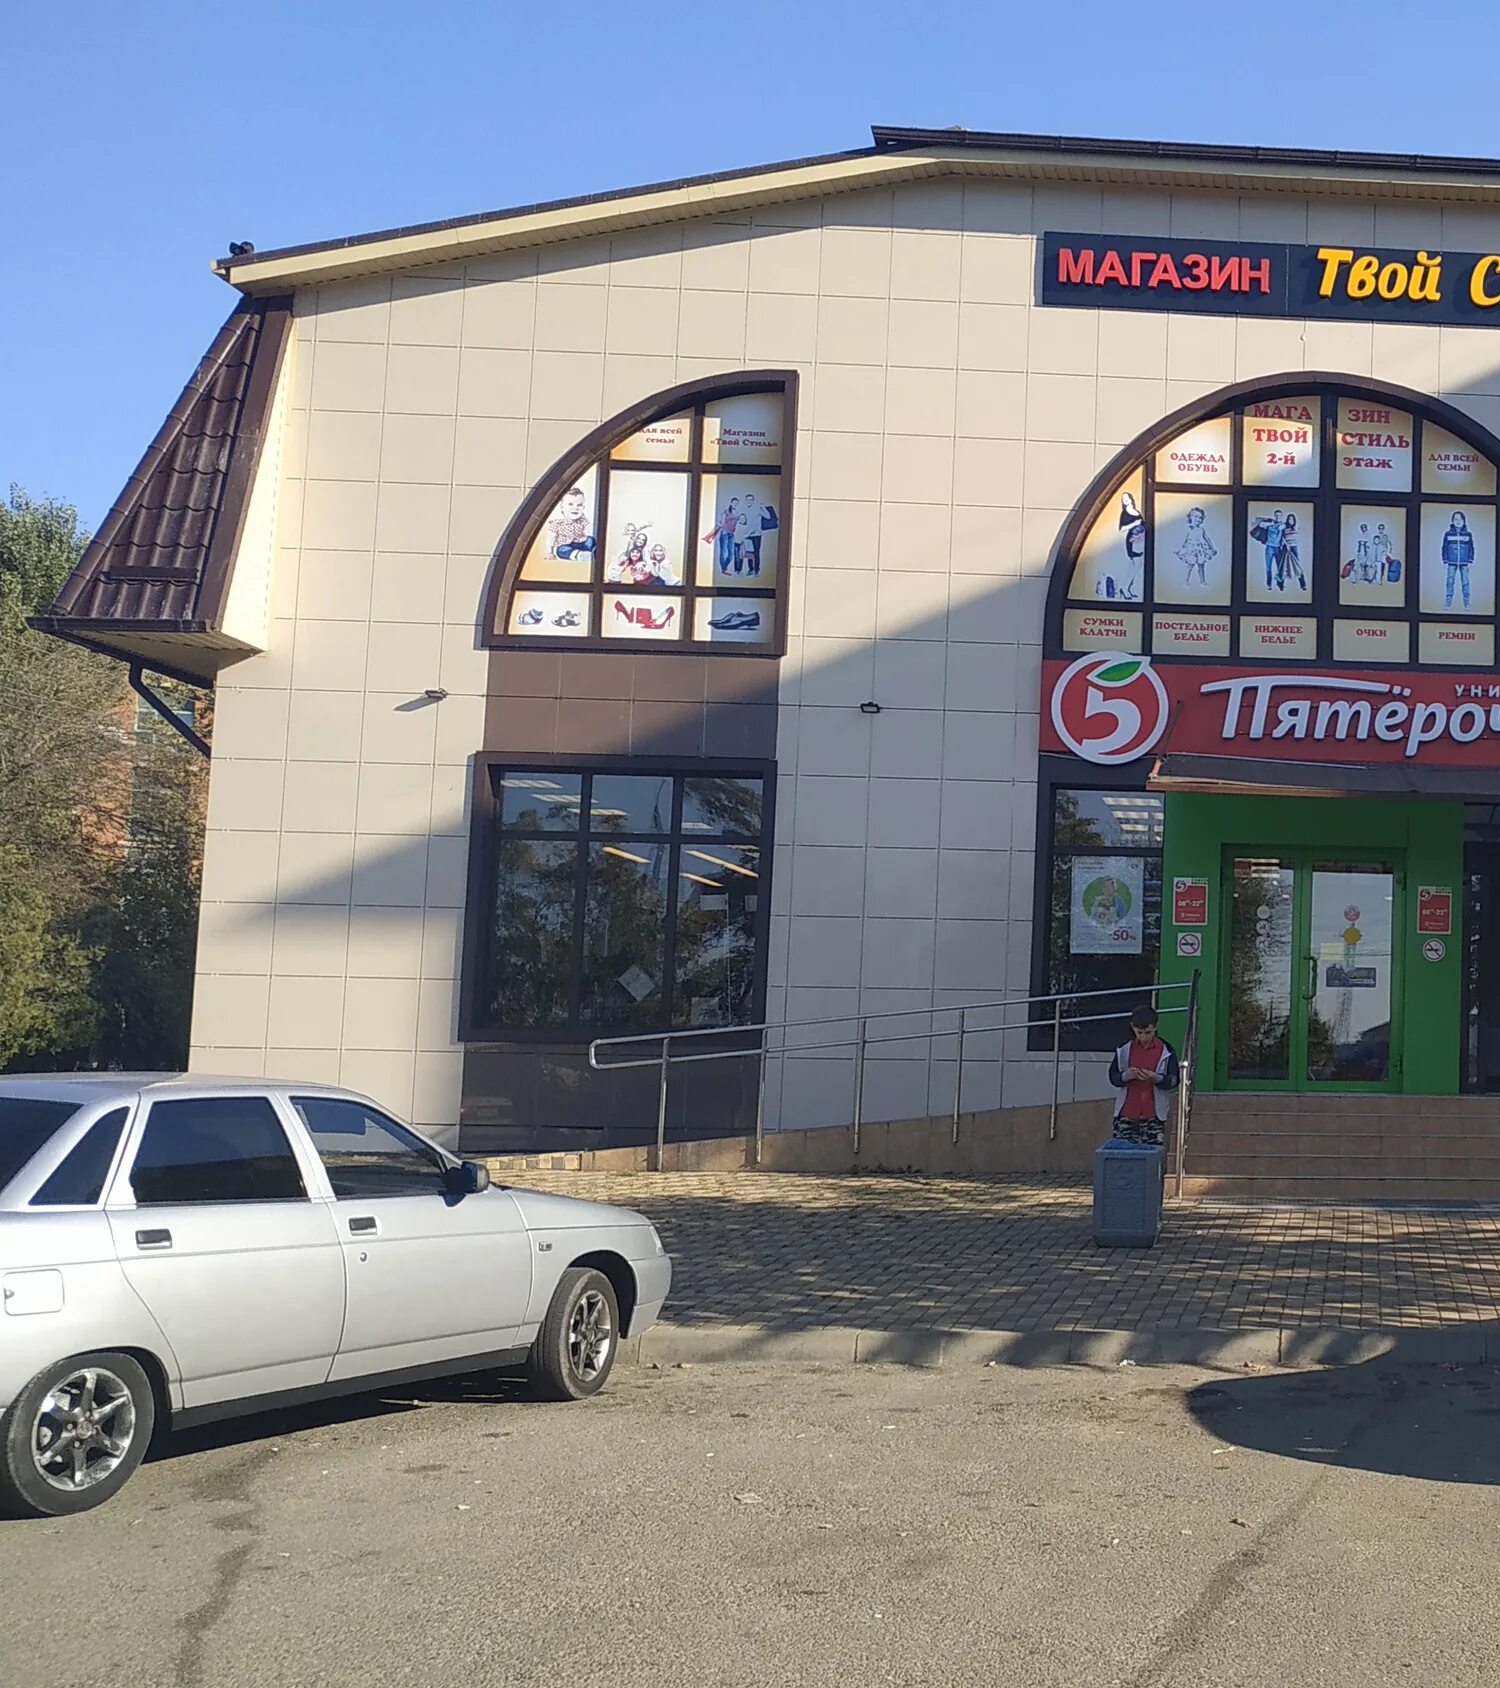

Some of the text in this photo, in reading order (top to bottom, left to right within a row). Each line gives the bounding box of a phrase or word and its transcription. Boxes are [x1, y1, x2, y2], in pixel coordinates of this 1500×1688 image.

[1057, 248, 1271, 294] МАГАЗИН
[1316, 247, 1442, 300] Твой
[1252, 404, 1391, 424] МАГА ЗИН
[723, 429, 766, 437] Магазин
[1252, 427, 1410, 449] ТВОЙ СТИЛЬ
[1170, 452, 1226, 464] ОДЕЖДА
[1342, 456, 1393, 469] этаж
[1428, 453, 1480, 463] ДЛЯ ВСЕЙ
[1178, 463, 1218, 473] ОБУВЬ
[1437, 463, 1471, 472] СЕМЬИ
[1083, 617, 1124, 628] СУМКИ
[1155, 621, 1229, 632] ПОСТЕЛЬНОЕ
[1079, 627, 1127, 638] КЛАТЧИ
[1254, 624, 1304, 635] НИЖНЕЕ
[1356, 628, 1387, 637] ОЧКИ
[1173, 632, 1210, 642] БЕЛЬЕ
[1261, 634, 1297, 645] БЕЛЬЕ
[1438, 631, 1476, 641] РЕМНИ
